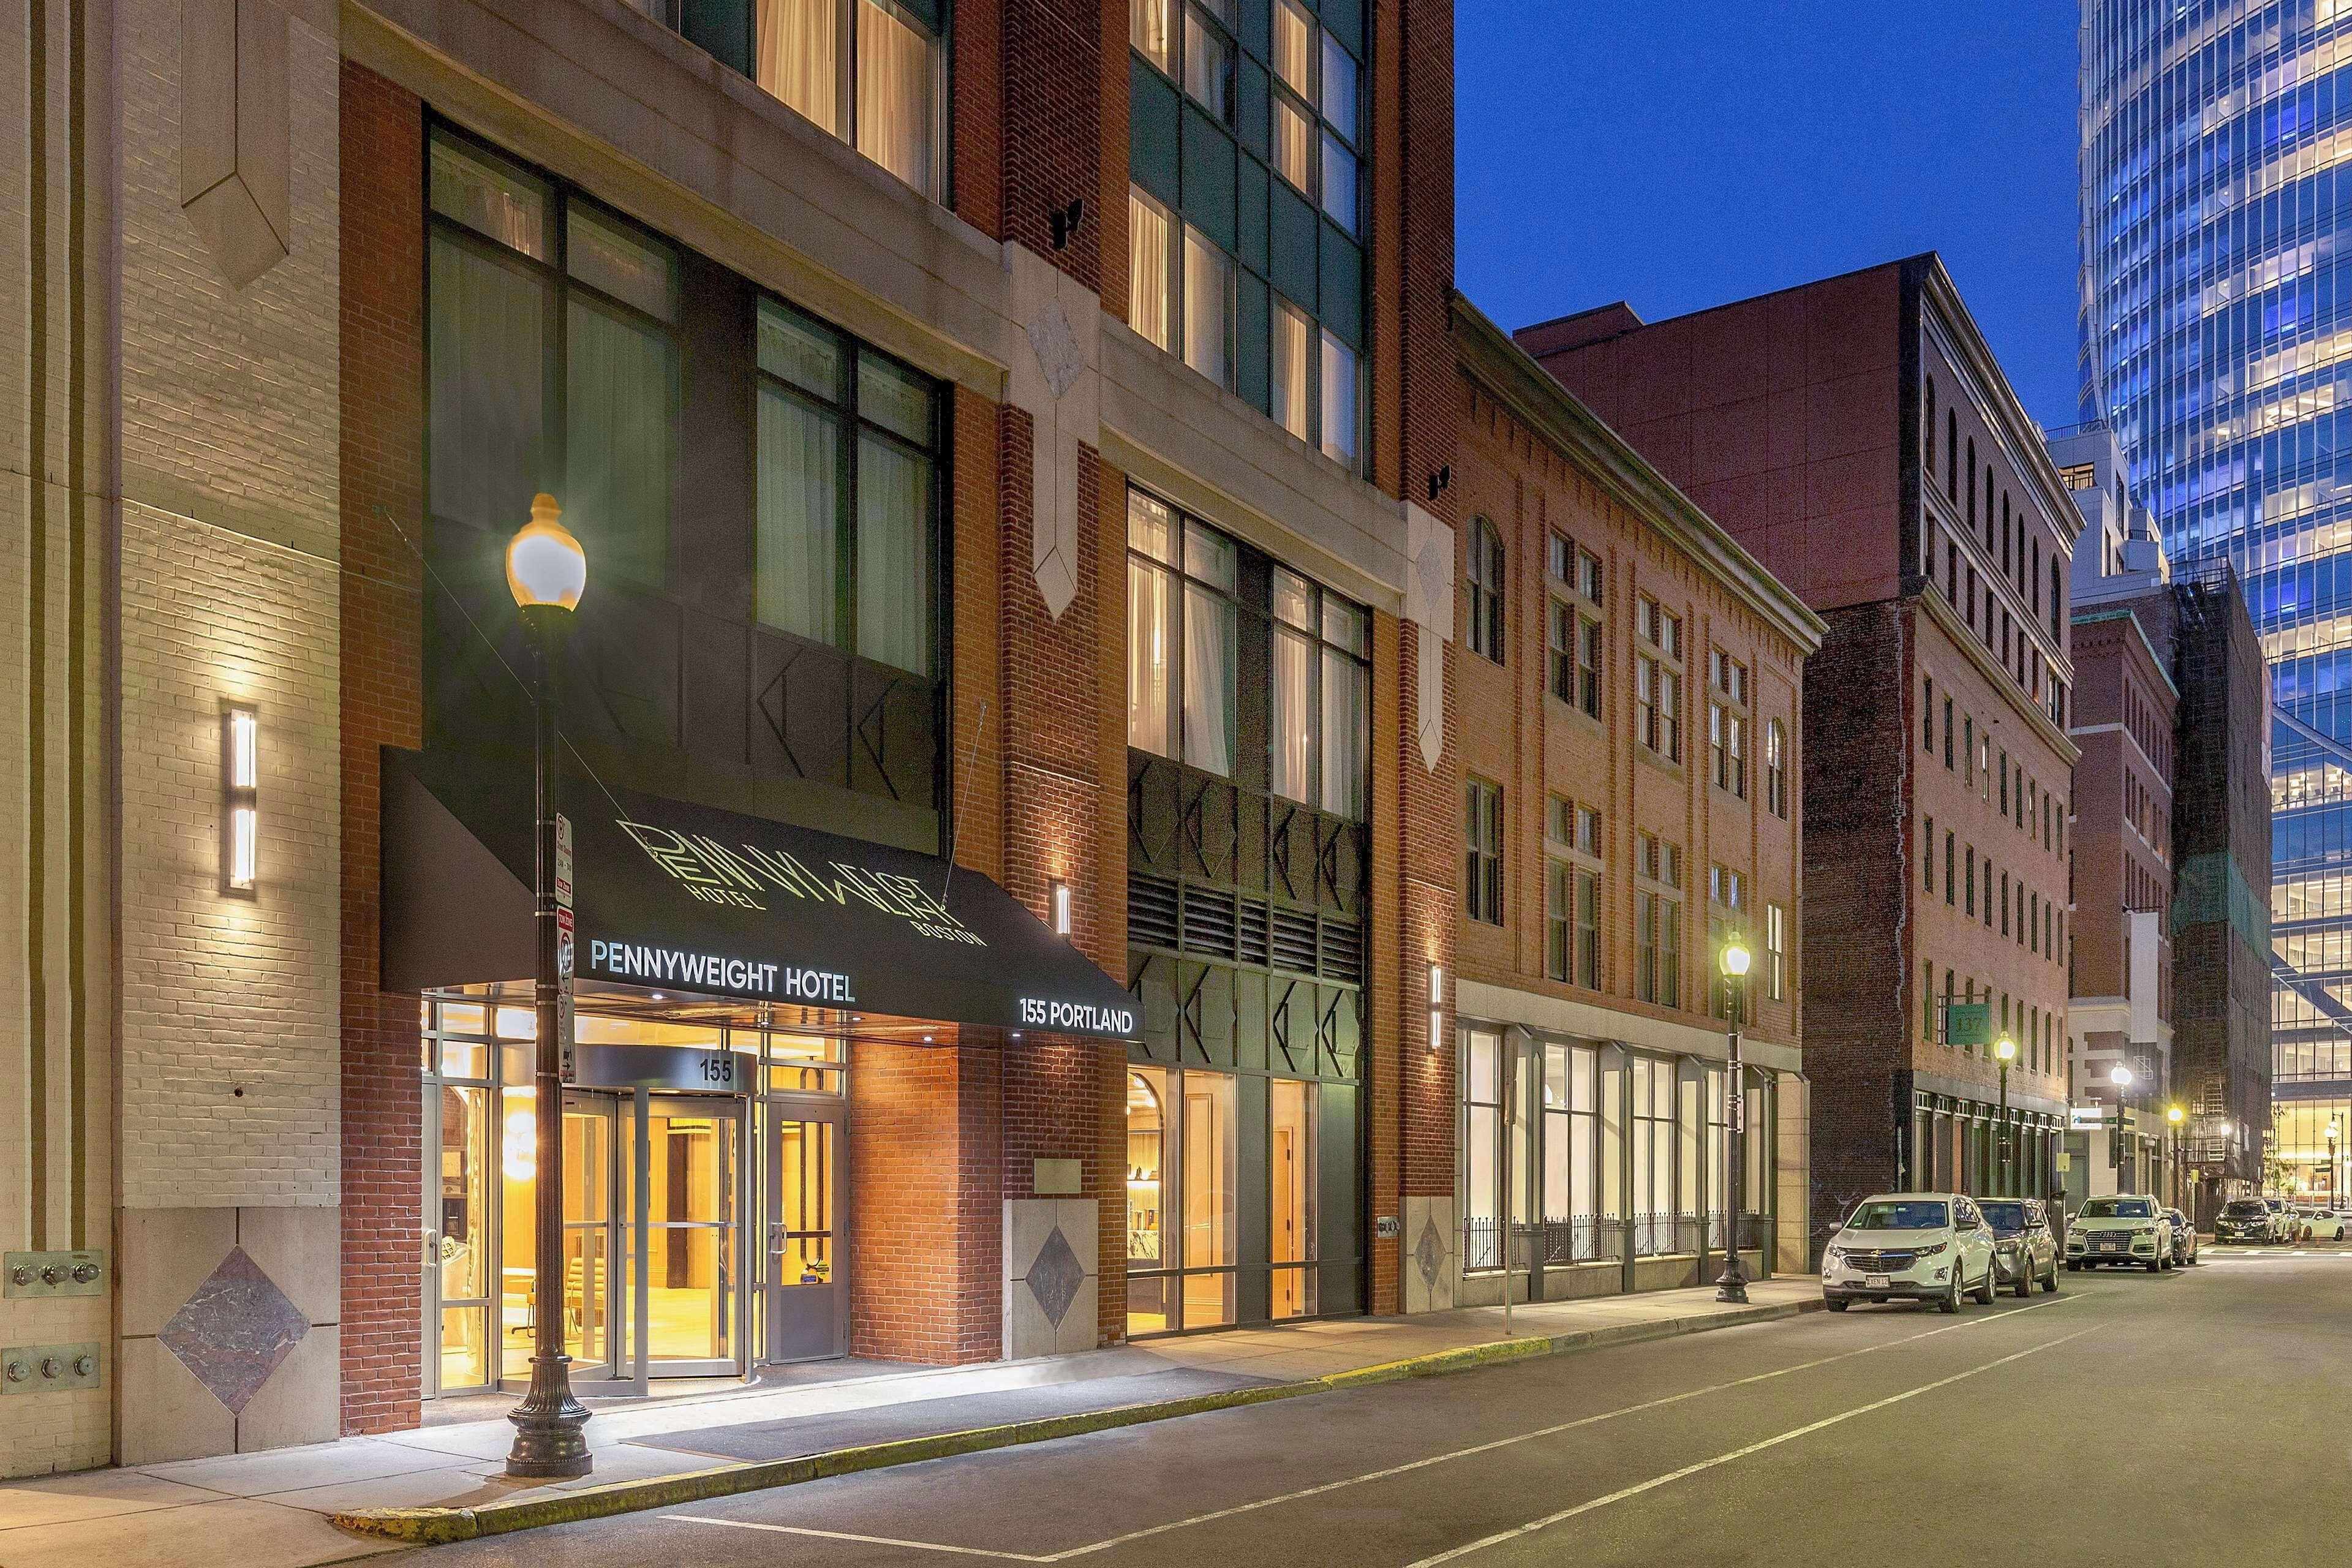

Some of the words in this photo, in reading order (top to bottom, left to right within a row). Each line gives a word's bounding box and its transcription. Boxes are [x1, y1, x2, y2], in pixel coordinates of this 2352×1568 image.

[683, 883, 767, 911] HOTEL
[909, 921, 988, 947] BOSTON
[591, 940, 778, 993] PENNYWEIGHT
[785, 967, 856, 1003] HOTEL
[1019, 998, 1046, 1024] 155
[1050, 1001, 1133, 1033] PORTLAND
[700, 1058, 731, 1082] 155
